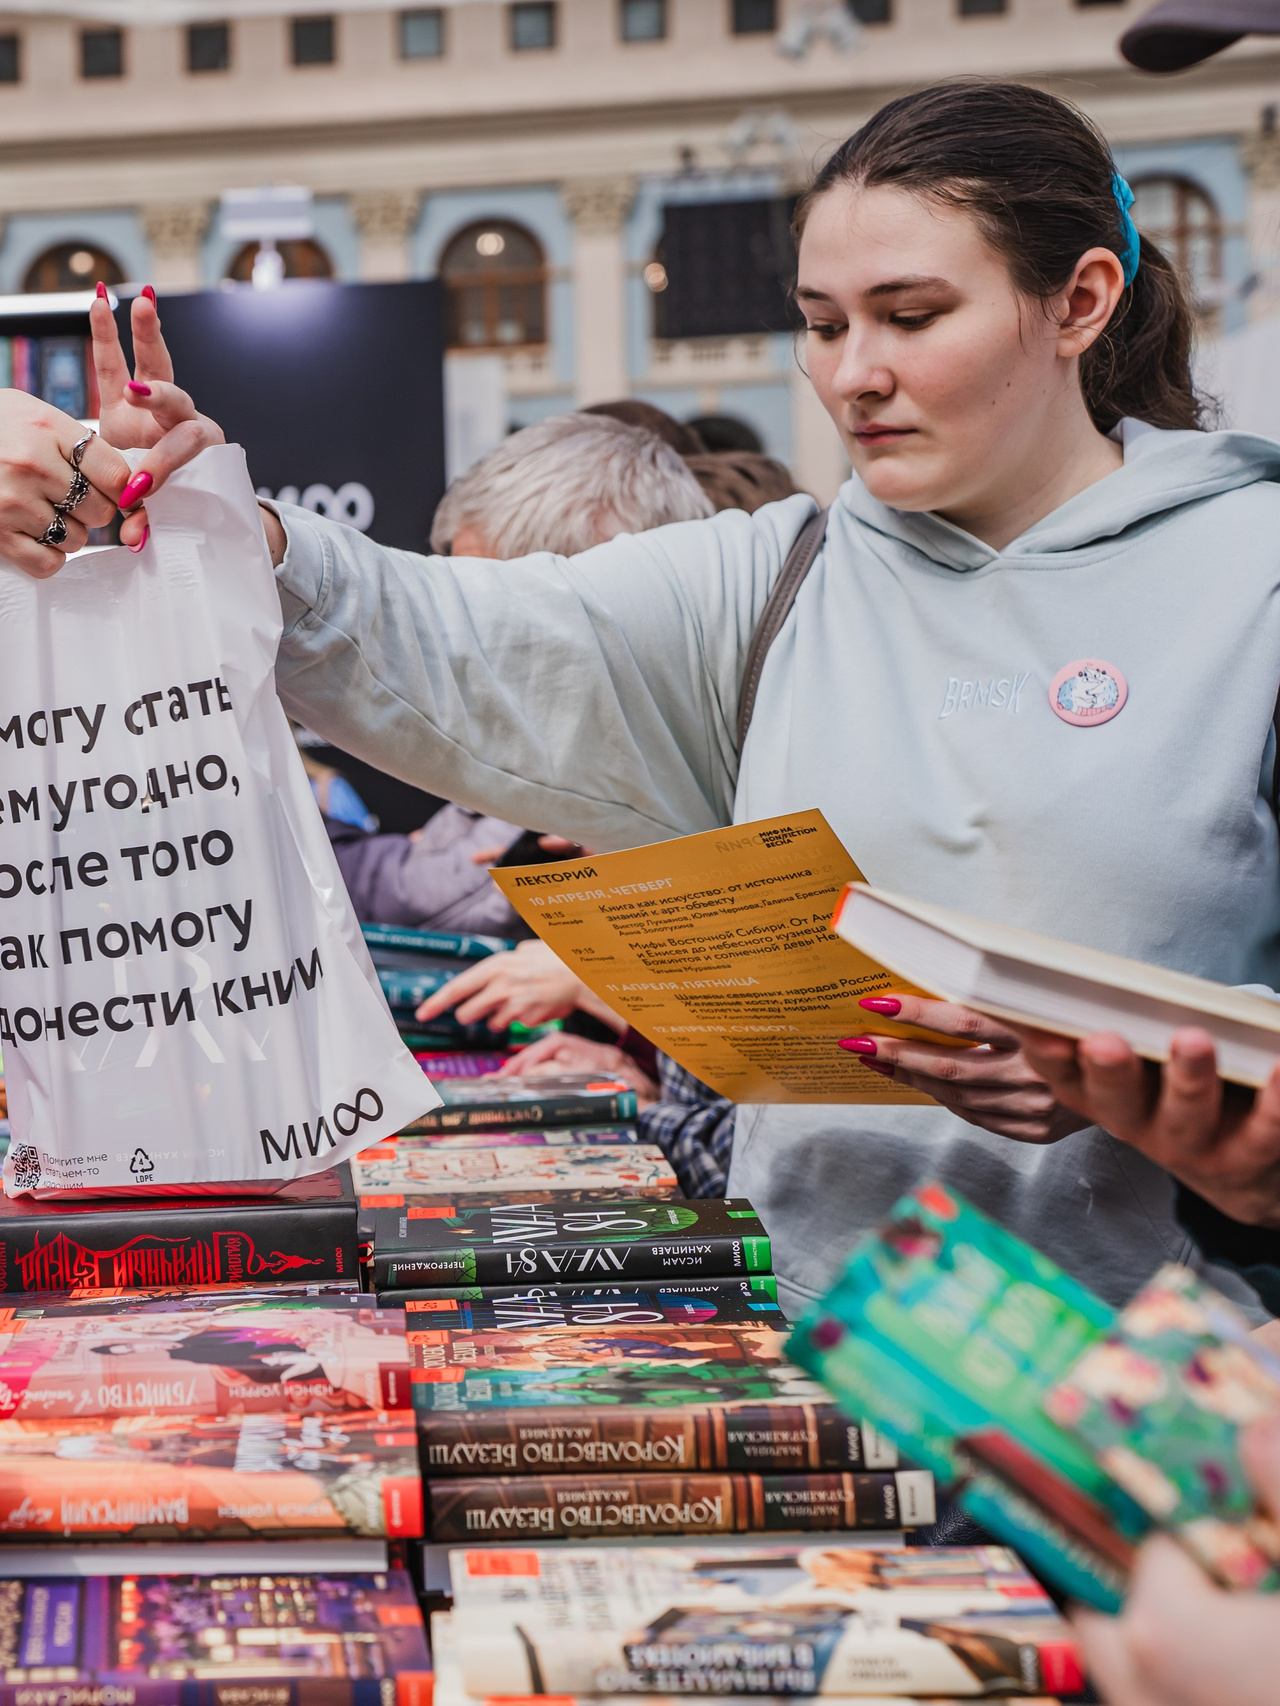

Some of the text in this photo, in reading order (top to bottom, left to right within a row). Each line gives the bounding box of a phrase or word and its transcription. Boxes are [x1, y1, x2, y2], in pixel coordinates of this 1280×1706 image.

[124, 677, 233, 735] стать
[47, 754, 240, 833] угодно,
[758, 826, 794, 839] МИФ НА
[765, 838, 794, 849] ВЕСНА
[120, 829, 235, 883] того
[514, 866, 598, 888] ЛЕКТОРИЙ
[528, 877, 673, 907] 10 АПРЕЛЯ, ЧЕТВЕРГ
[598, 868, 813, 914] Книга как искусство: от источника
[540, 911, 565, 920] 18:15
[606, 896, 735, 923] знаний к арт-объекту
[612, 920, 645, 931] Виктор
[691, 910, 719, 921] Юлия
[719, 902, 763, 917] Чернова,
[762, 895, 795, 908] Галина
[795, 886, 840, 901] Ересина,
[60, 899, 253, 966] помогу
[548, 918, 584, 927] Антикафе
[619, 922, 695, 937] Анна Золотухина
[628, 912, 836, 951] Мифы Восточной Сибири. От Анг
[571, 947, 595, 956] 19:15
[646, 948, 688, 959] Енисея
[690, 945, 707, 955] до
[708, 936, 773, 952] небесного
[776, 925, 827, 941] кузнеца
[714, 942, 781, 960] солнечной
[783, 939, 815, 951] девы
[212, 946, 324, 1018] книи
[649, 967, 683, 975] Татьяна
[605, 976, 760, 993] 11 АПРЕЛЯ, ПЯТНИЦА
[674, 971, 891, 1001] Шаманы северных народов России.
[683, 981, 892, 1008] Железные кости, духи-помощники
[699, 1006, 741, 1015] полеты
[743, 1003, 781, 1014] между
[783, 1002, 831, 1013] мирами
[729, 1023, 800, 1033] СУББОТА
[43, 1153, 108, 1167] Помгите мне
[45, 1167, 100, 1179] стат чем-то
[135, 1173, 154, 1184] LDPE
[224, 1237, 244, 1283] РИЛОГИЯ
[651, 1244, 712, 1256] ХАНИПАЕВ
[392, 1260, 465, 1272] ПЕРЕРОЖДЕНИЕ
[506, 1247, 538, 1278] 84
[662, 1256, 703, 1267] ИСЛАМ
[422, 1343, 446, 1369] ОРОЛЕВСТ
[98, 1376, 196, 1417] УБИЙСТВО
[229, 1383, 333, 1398] НЭНСИ УОРРЕН
[519, 1427, 592, 1441] АКАДЕМИЯ
[429, 1434, 686, 1466] КОРОЛЕВСТВО БЕЗДУШ
[466, 1495, 722, 1532] КОРОЛЕВСТВО БЕЗДУШ
